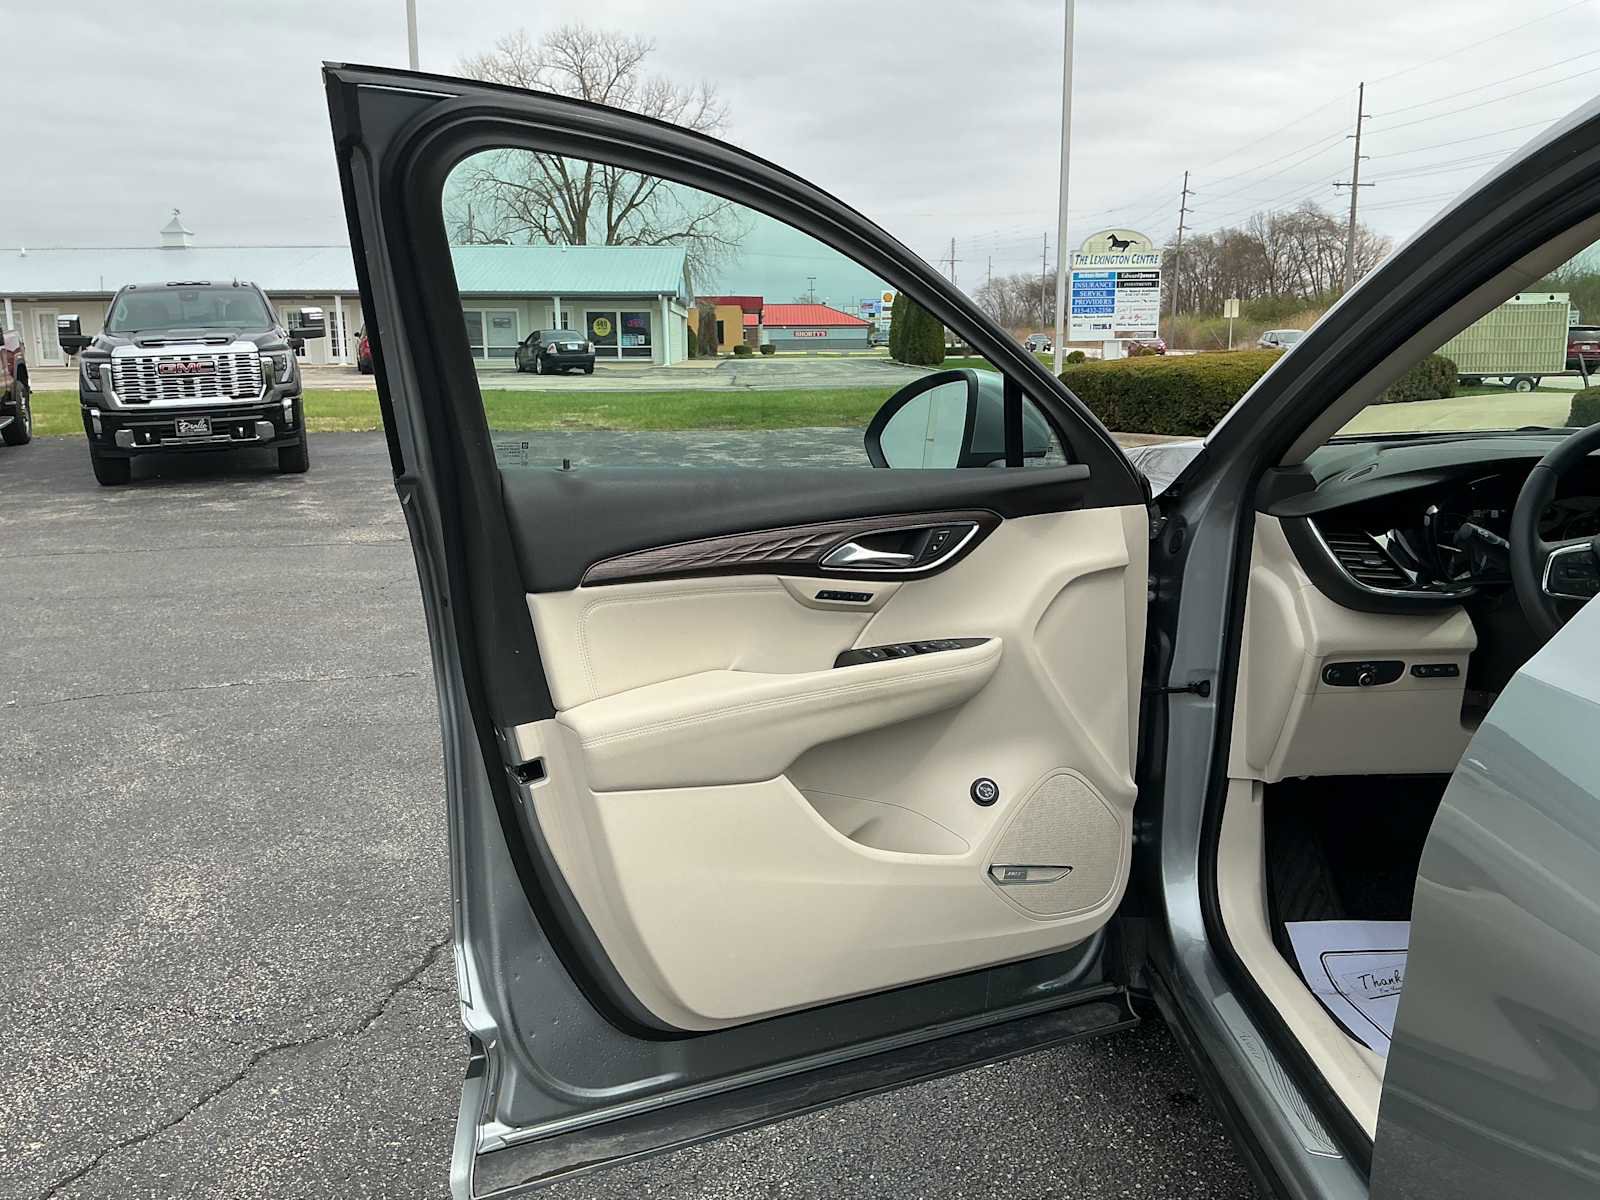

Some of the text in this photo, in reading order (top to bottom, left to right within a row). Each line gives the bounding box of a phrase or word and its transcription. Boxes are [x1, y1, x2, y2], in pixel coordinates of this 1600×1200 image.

[1075, 254, 1159, 265] THE LEXINGTON CENTRE
[159, 362, 214, 374] GMC
